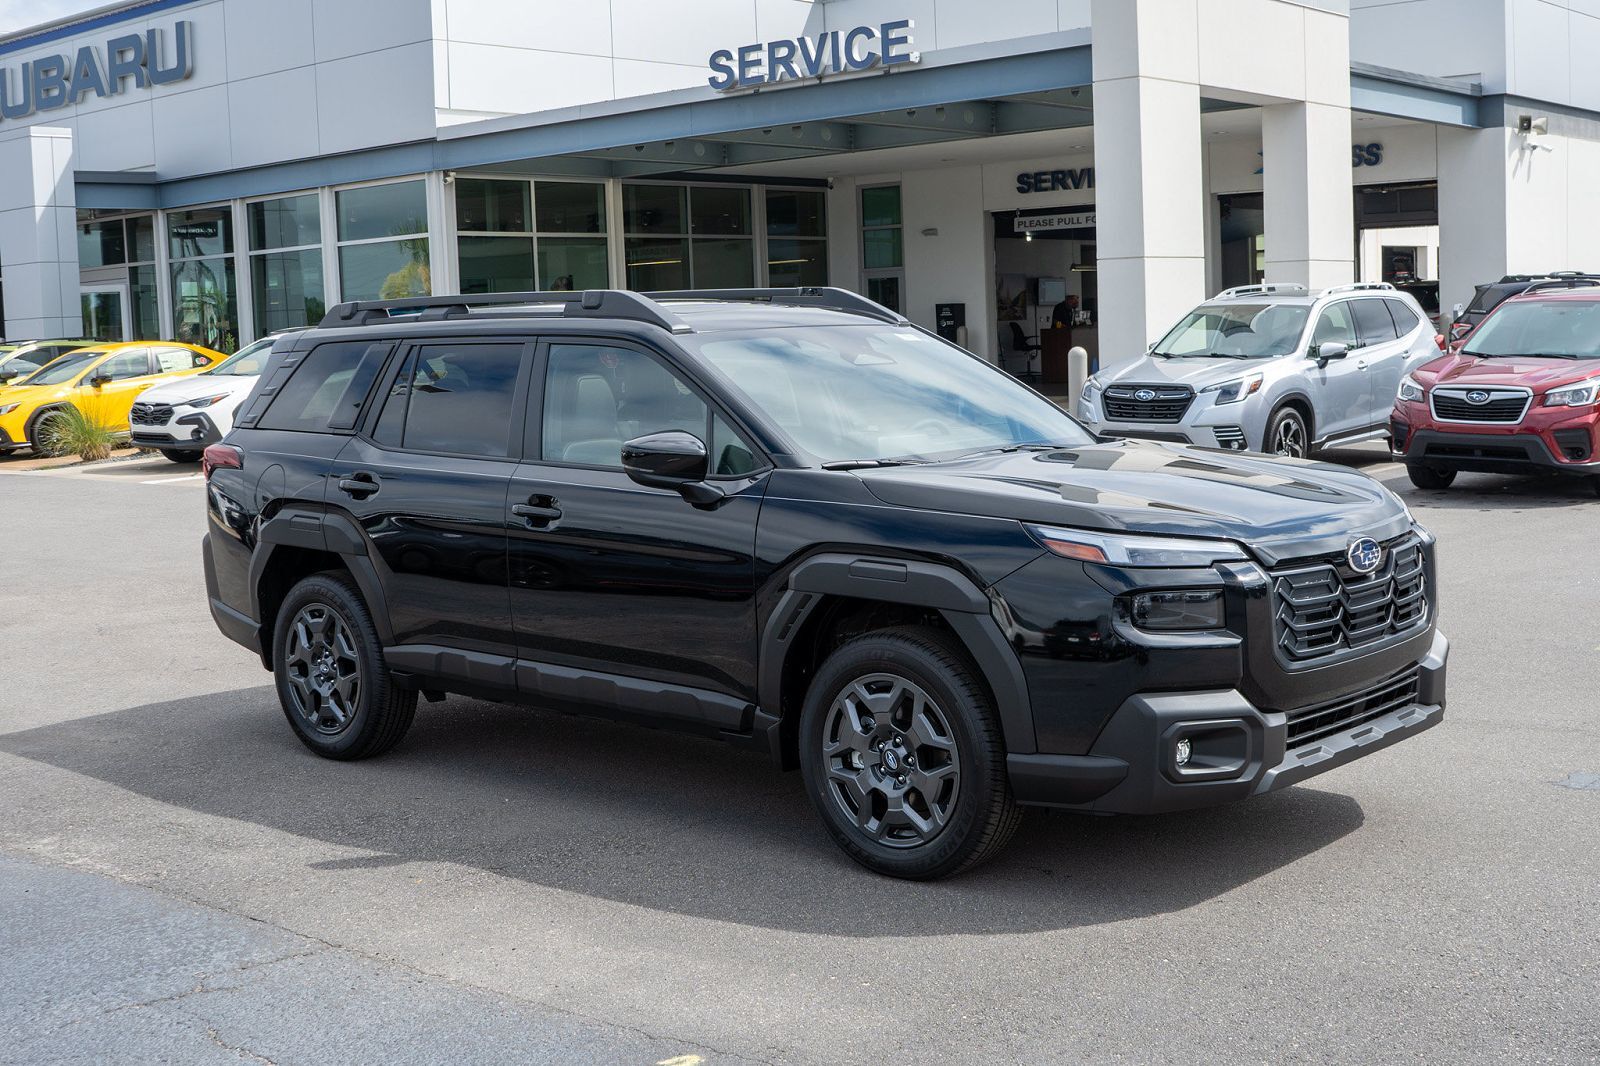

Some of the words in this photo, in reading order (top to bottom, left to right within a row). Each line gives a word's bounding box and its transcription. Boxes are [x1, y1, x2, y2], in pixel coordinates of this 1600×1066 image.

[0, 21, 190, 119] UBARU
[708, 20, 911, 90] SERVICE
[1016, 168, 1095, 193] SERVI
[1017, 218, 1054, 229] PLEASE
[1057, 216, 1082, 225] PULL
